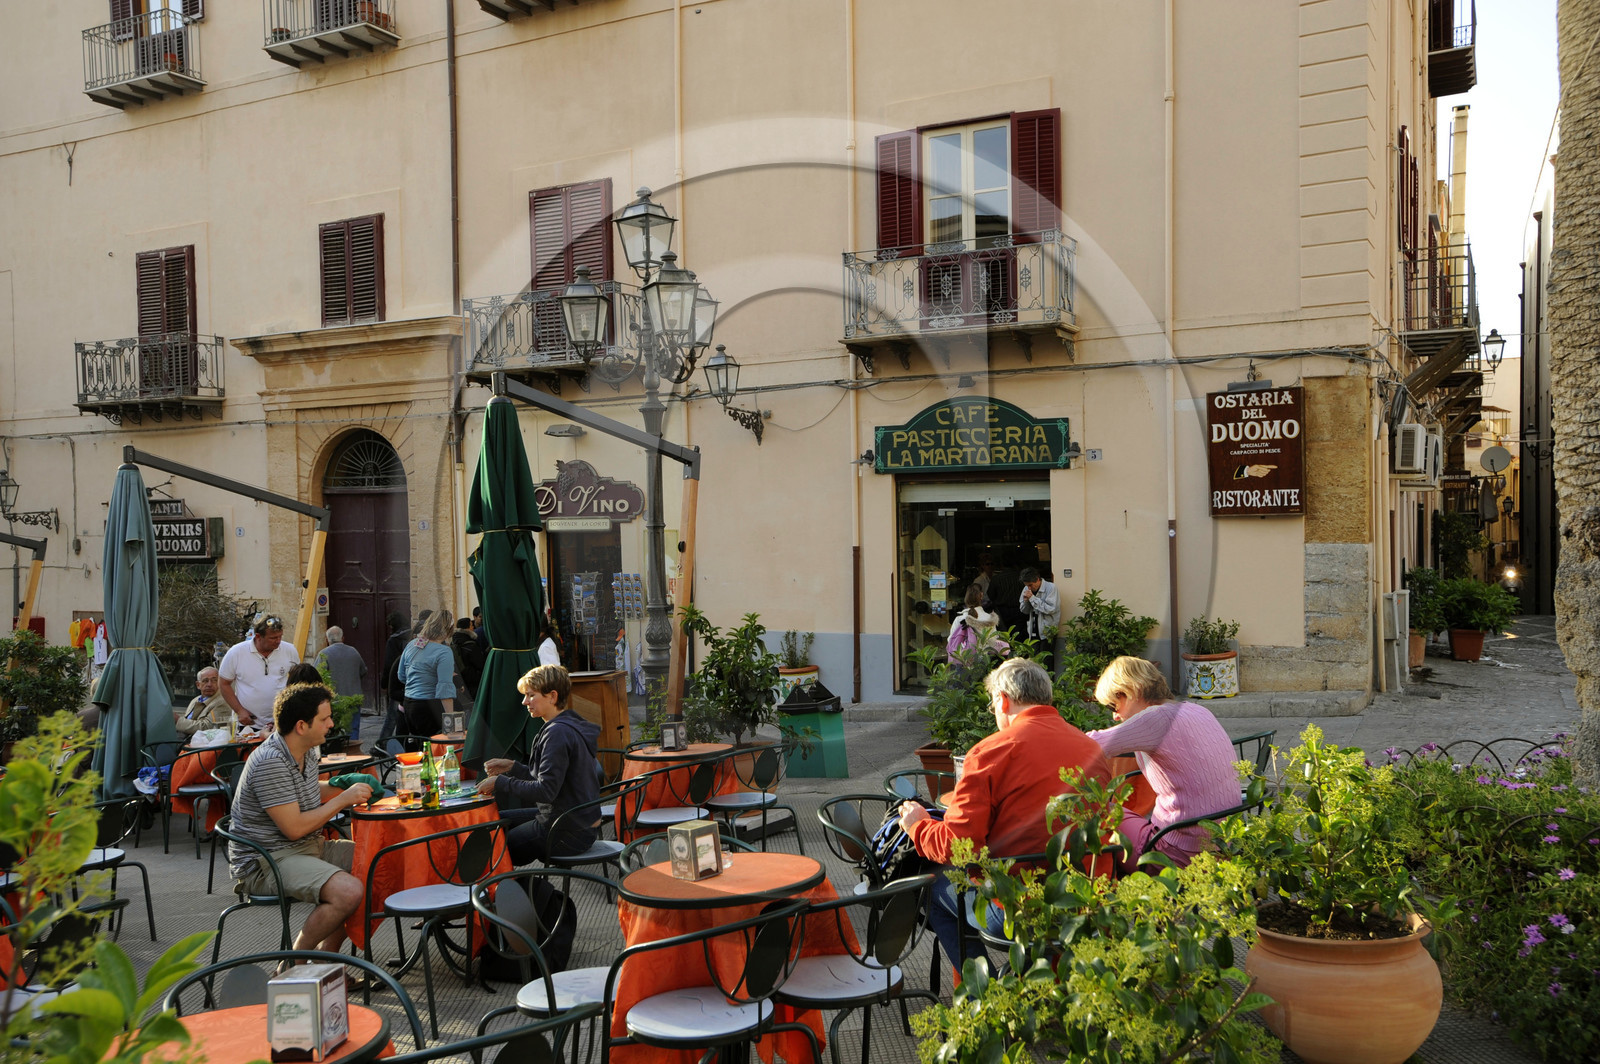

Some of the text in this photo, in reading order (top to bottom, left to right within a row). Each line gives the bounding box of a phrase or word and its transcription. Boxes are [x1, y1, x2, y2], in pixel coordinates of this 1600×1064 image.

[1214, 391, 1294, 408] OSTARIA
[936, 405, 999, 425] CAFE
[1242, 408, 1266, 419] DEL
[893, 425, 1047, 448] PASTICCERIA
[1211, 419, 1300, 443] DUOMO
[887, 444, 1052, 467] LA MARTORANA
[1212, 488, 1300, 509] RISTORANTE
